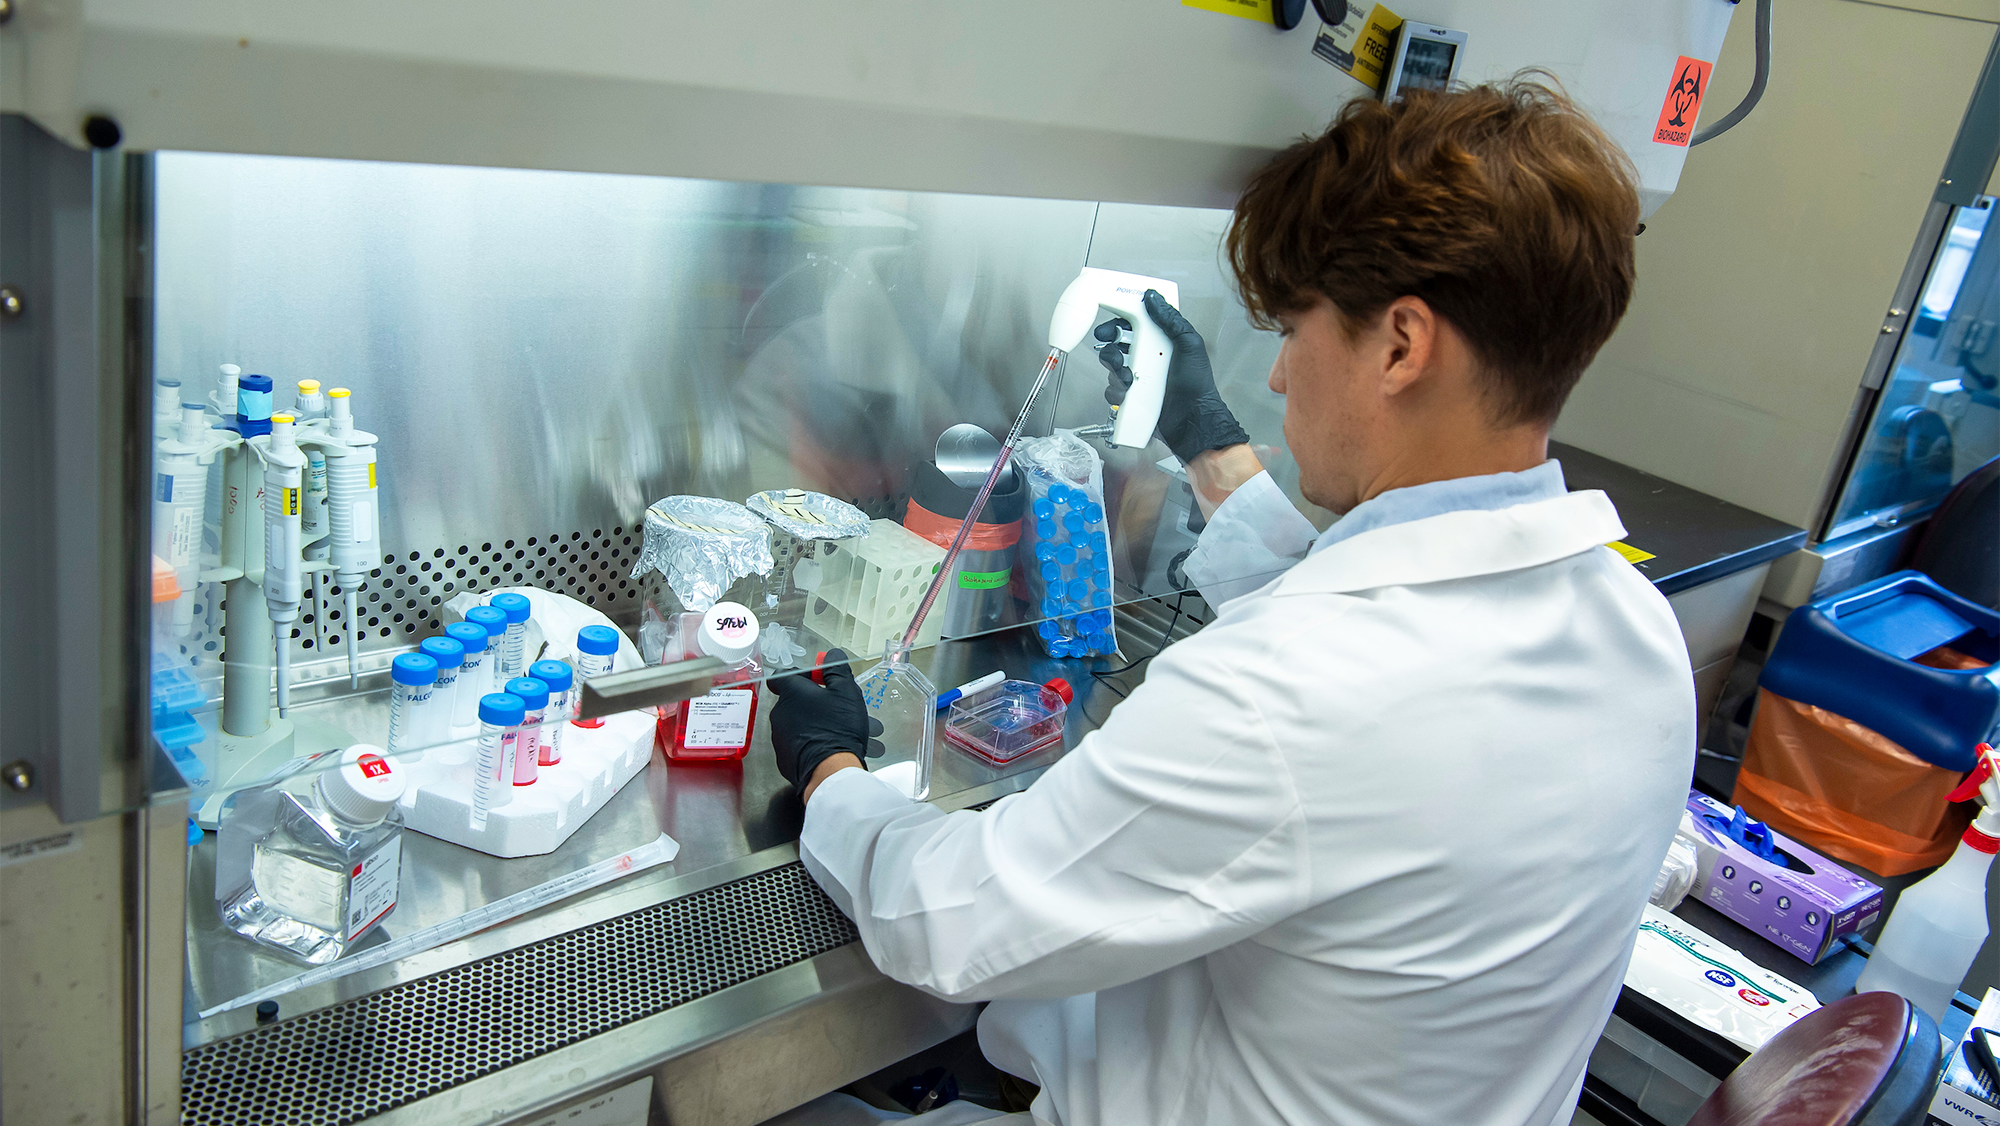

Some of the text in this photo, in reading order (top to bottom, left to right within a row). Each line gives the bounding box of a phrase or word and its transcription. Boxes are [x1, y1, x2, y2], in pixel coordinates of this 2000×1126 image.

[1363, 36, 1388, 62] FREE
[1658, 129, 1687, 143] BIOHAZARD
[1116, 287, 1145, 295] POWERP
[460, 659, 482, 669] CON
[433, 675, 457, 685] LCON
[407, 692, 434, 702] FALCO
[554, 699, 567, 707] FAL
[368, 763, 386, 776] 1X
[1707, 971, 1733, 986] NSF
[1943, 1096, 1975, 1118] VWR
